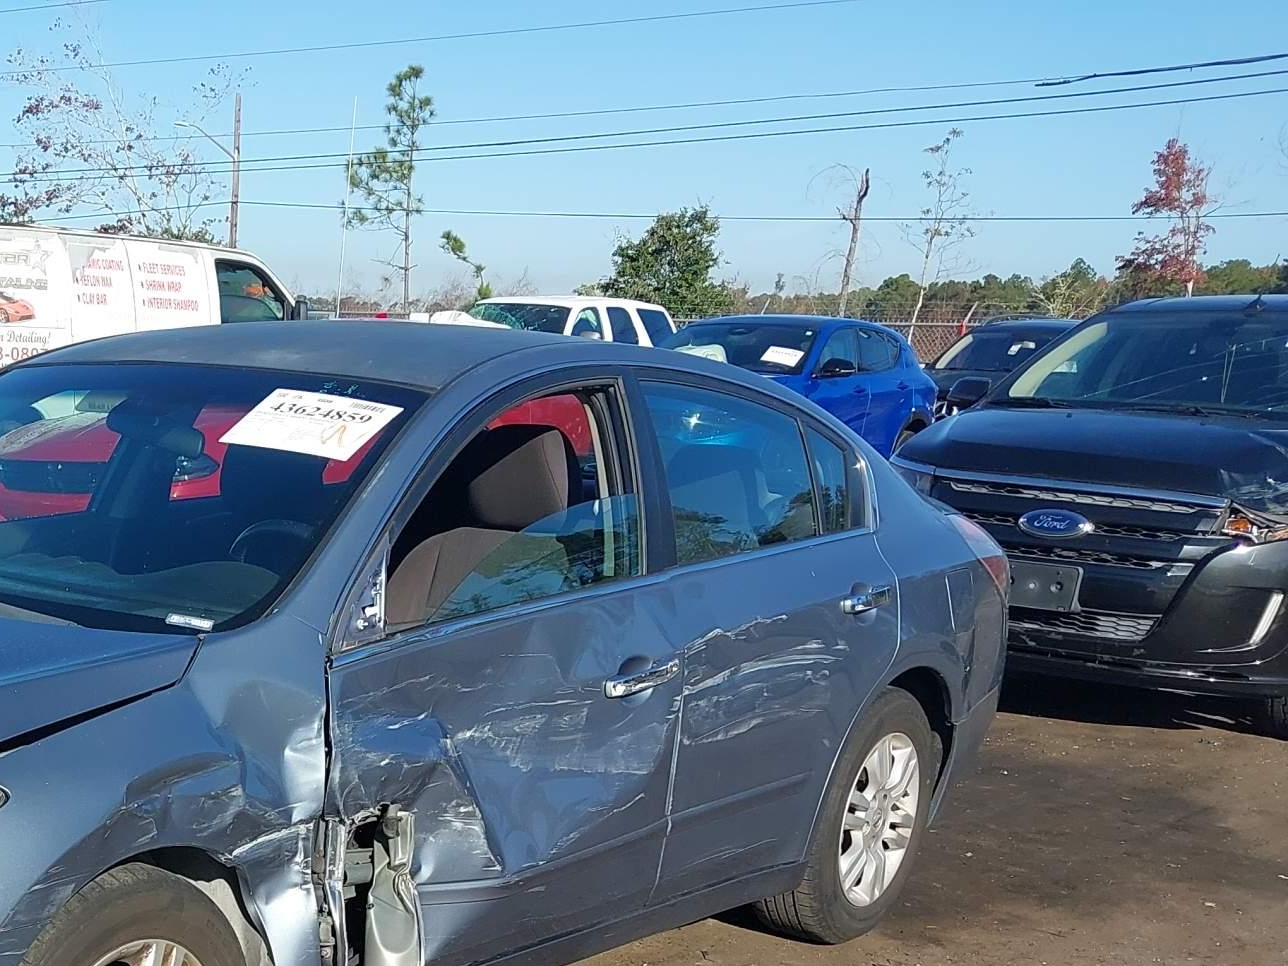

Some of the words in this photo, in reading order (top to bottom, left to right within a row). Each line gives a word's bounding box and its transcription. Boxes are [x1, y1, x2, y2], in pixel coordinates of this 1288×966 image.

[142, 262, 159, 275] FLEET
[159, 263, 186, 277] SERVICES
[167, 282, 182, 294] WRAP
[146, 297, 173, 310] INTERIOR
[173, 299, 200, 313] SHAMPOO
[270, 402, 373, 424] 43624859
[1034, 515, 1071, 529] Ford
